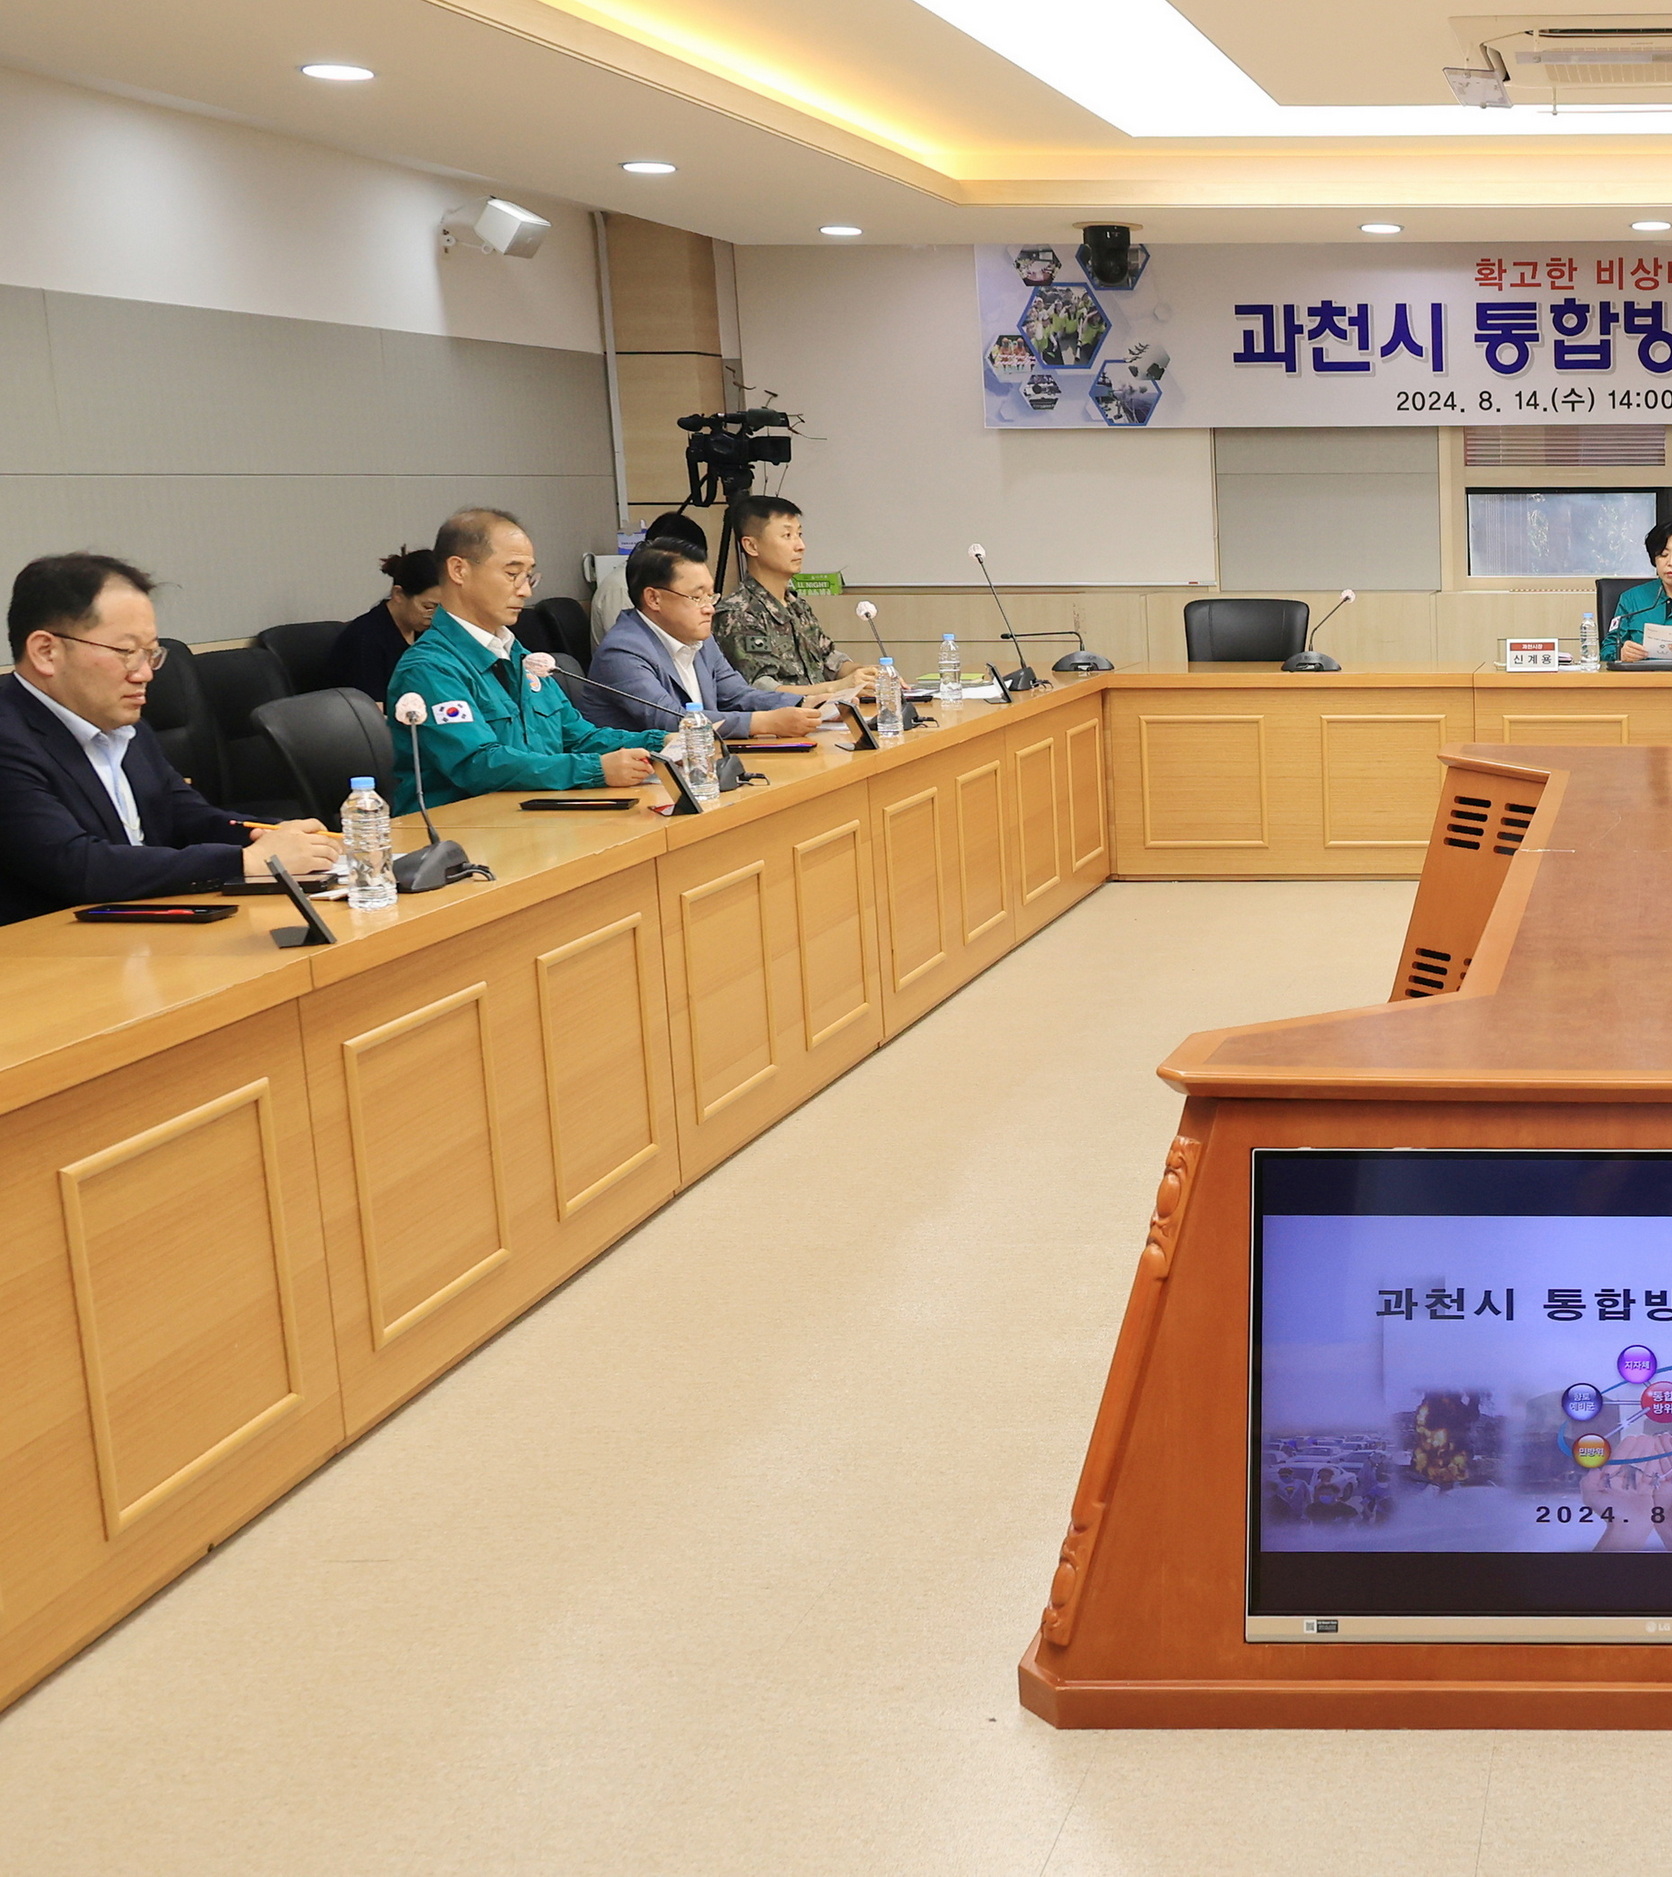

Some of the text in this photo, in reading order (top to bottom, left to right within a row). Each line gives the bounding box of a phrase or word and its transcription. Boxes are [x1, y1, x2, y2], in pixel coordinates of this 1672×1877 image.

[1475, 256, 1580, 292] 확고한
[1234, 300, 1445, 374] 과천시
[1396, 391, 1466, 412] 2024.
[1478, 391, 1502, 412] 8.
[1515, 387, 1596, 413] 14.(수)
[1375, 1287, 1515, 1322] 과천시
[1624, 1361, 1651, 1370] 지자체
[1536, 1505, 1630, 1525] 2024.
[1658, 1623, 1671, 1631] LG
